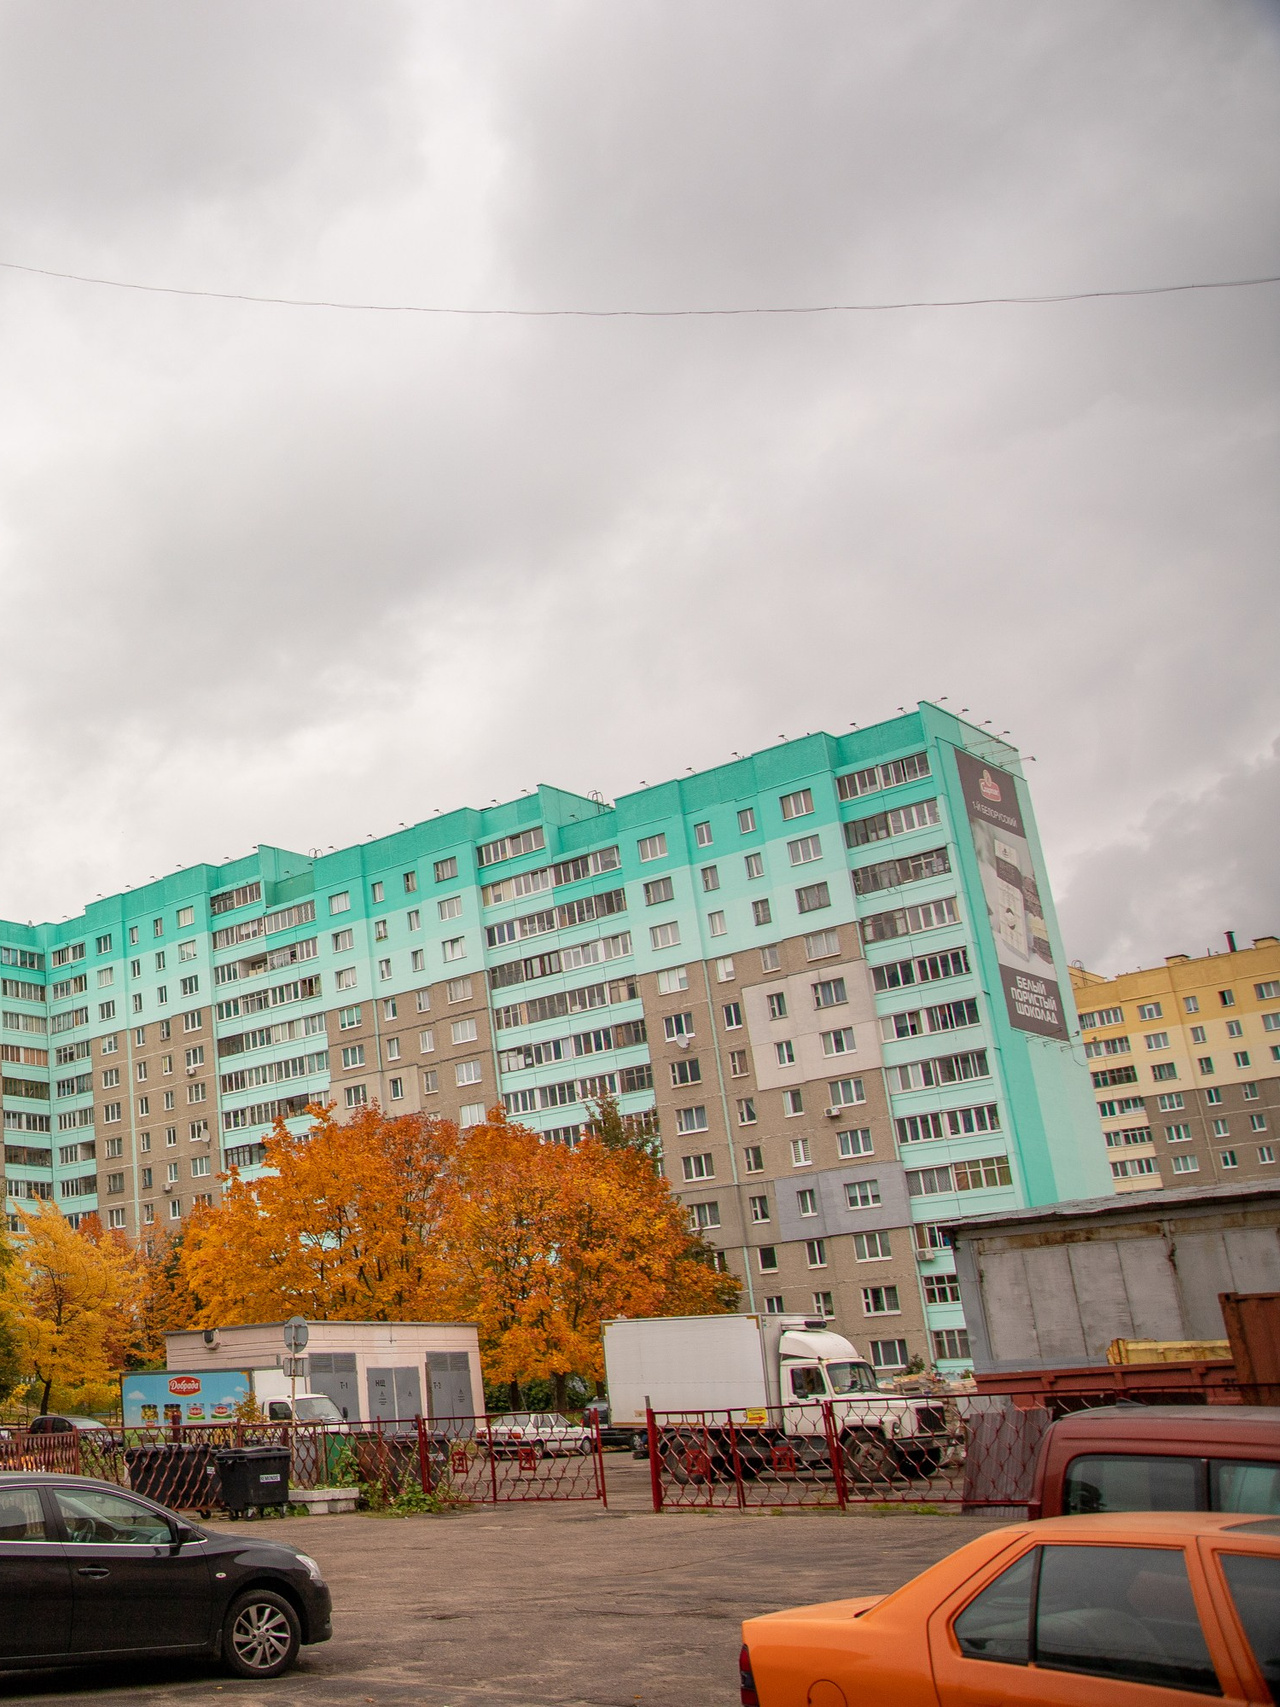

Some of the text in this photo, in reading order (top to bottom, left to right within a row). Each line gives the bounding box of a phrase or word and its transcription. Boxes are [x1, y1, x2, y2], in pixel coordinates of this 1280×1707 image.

[1016, 975, 1047, 996] БЕЛЫЙ
[1010, 986, 1058, 1012] ПОРИСТЫЙ
[1015, 1001, 1059, 1025] ШОКОЛАД
